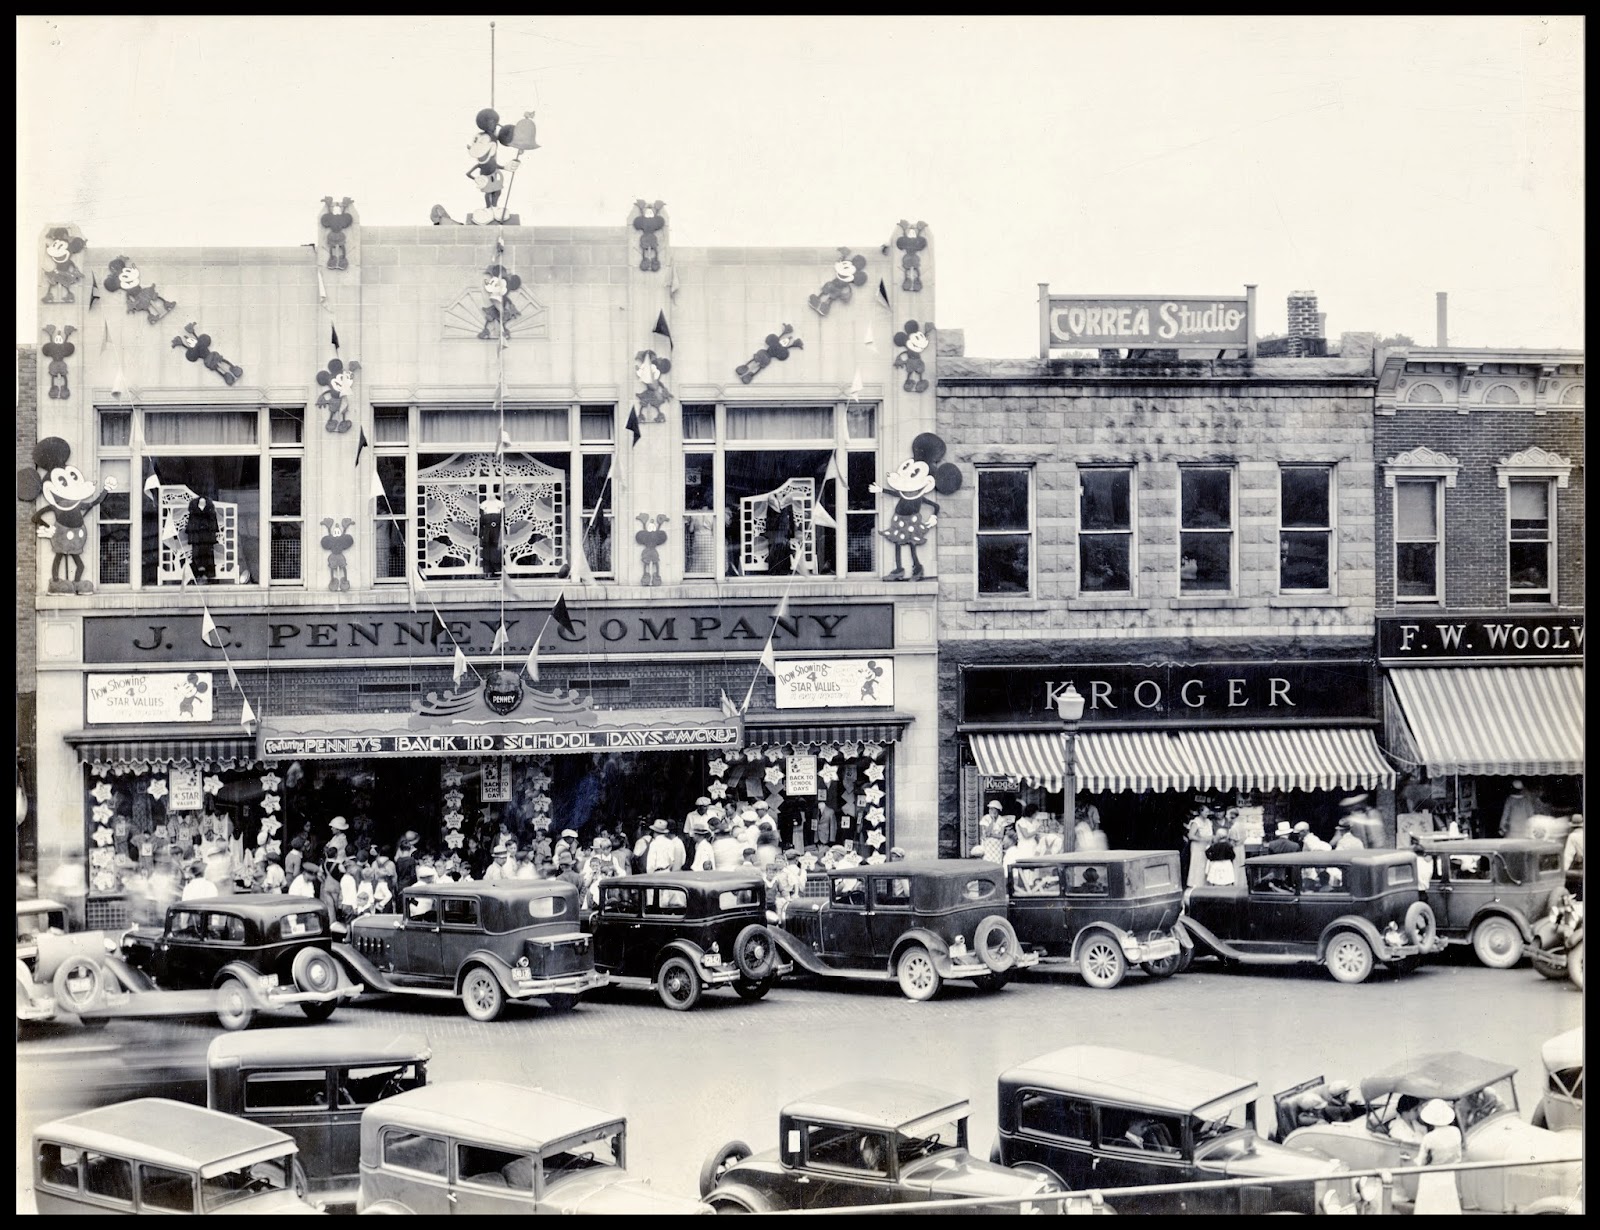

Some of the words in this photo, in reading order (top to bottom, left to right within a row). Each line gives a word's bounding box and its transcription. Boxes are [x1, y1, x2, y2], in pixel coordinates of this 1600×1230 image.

[1050, 306, 1150, 341] CORREA
[1158, 302, 1246, 339] Studio
[133, 626, 173, 650] J.
[202, 625, 242, 648] C.
[268, 620, 520, 647] PENNEY
[557, 614, 848, 641] COMPANY
[1400, 625, 1428, 650] F.
[1436, 624, 1473, 649] W.
[795, 663, 832, 677] Showing
[807, 672, 817, 682] 4
[108, 676, 148, 693] Showing
[791, 682, 812, 692] STAR
[814, 681, 841, 692] VALUES
[126, 688, 135, 697] 4
[1044, 678, 1297, 709] KROGER
[107, 698, 128, 707] STAR
[133, 698, 164, 706] VALUES
[395, 736, 457, 751] BACK
[463, 736, 494, 750] TO
[503, 733, 596, 749] SCHOOL
[606, 731, 663, 746] DAYS
[675, 729, 736, 743] MICKEY
[181, 792, 199, 800] STAR
